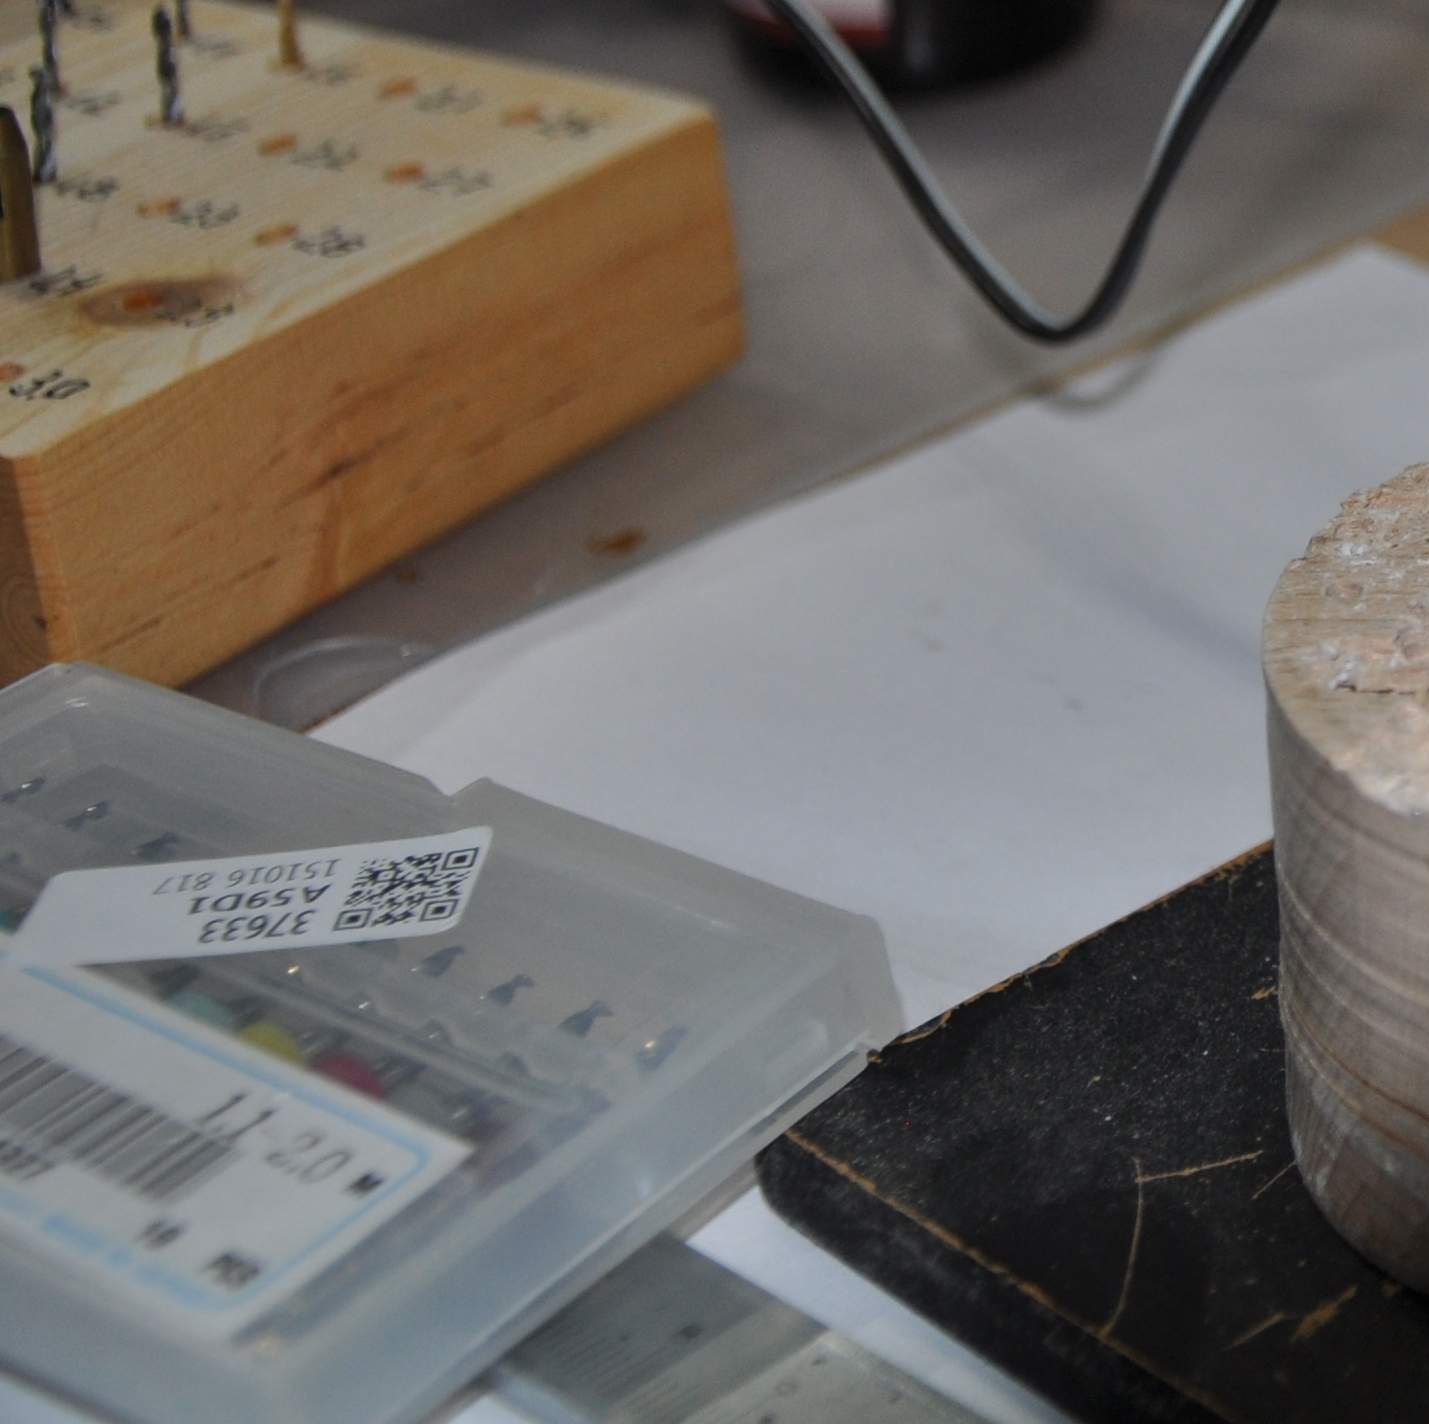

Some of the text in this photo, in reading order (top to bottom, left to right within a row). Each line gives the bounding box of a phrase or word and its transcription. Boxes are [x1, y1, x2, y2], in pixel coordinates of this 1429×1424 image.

[152, 858, 341, 895] 151016 817
[187, 883, 332, 915] A59D1
[197, 909, 317, 944] 37633
